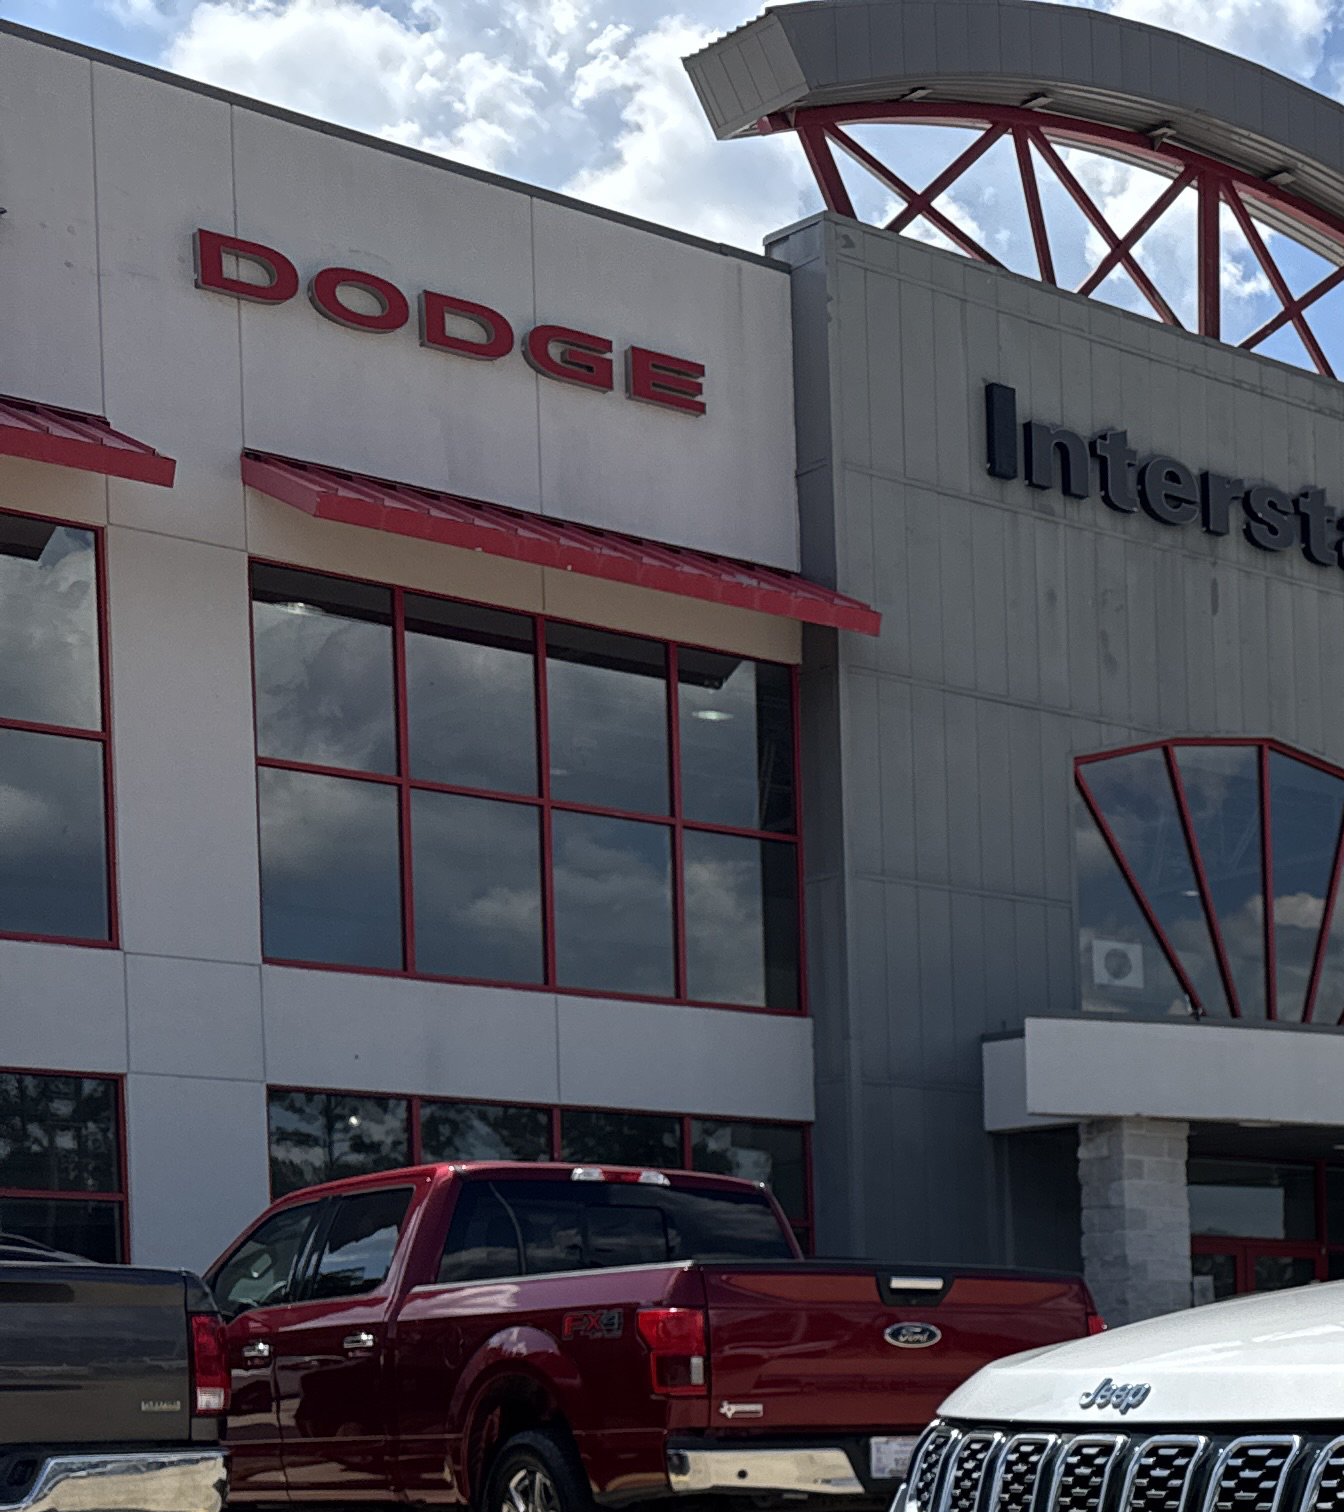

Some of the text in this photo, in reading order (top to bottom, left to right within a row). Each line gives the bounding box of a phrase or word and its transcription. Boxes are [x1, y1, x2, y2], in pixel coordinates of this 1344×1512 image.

[192, 228, 707, 417] DODGE
[562, 1309, 623, 1340] FX4
[1079, 1377, 1152, 1416] Jeep
